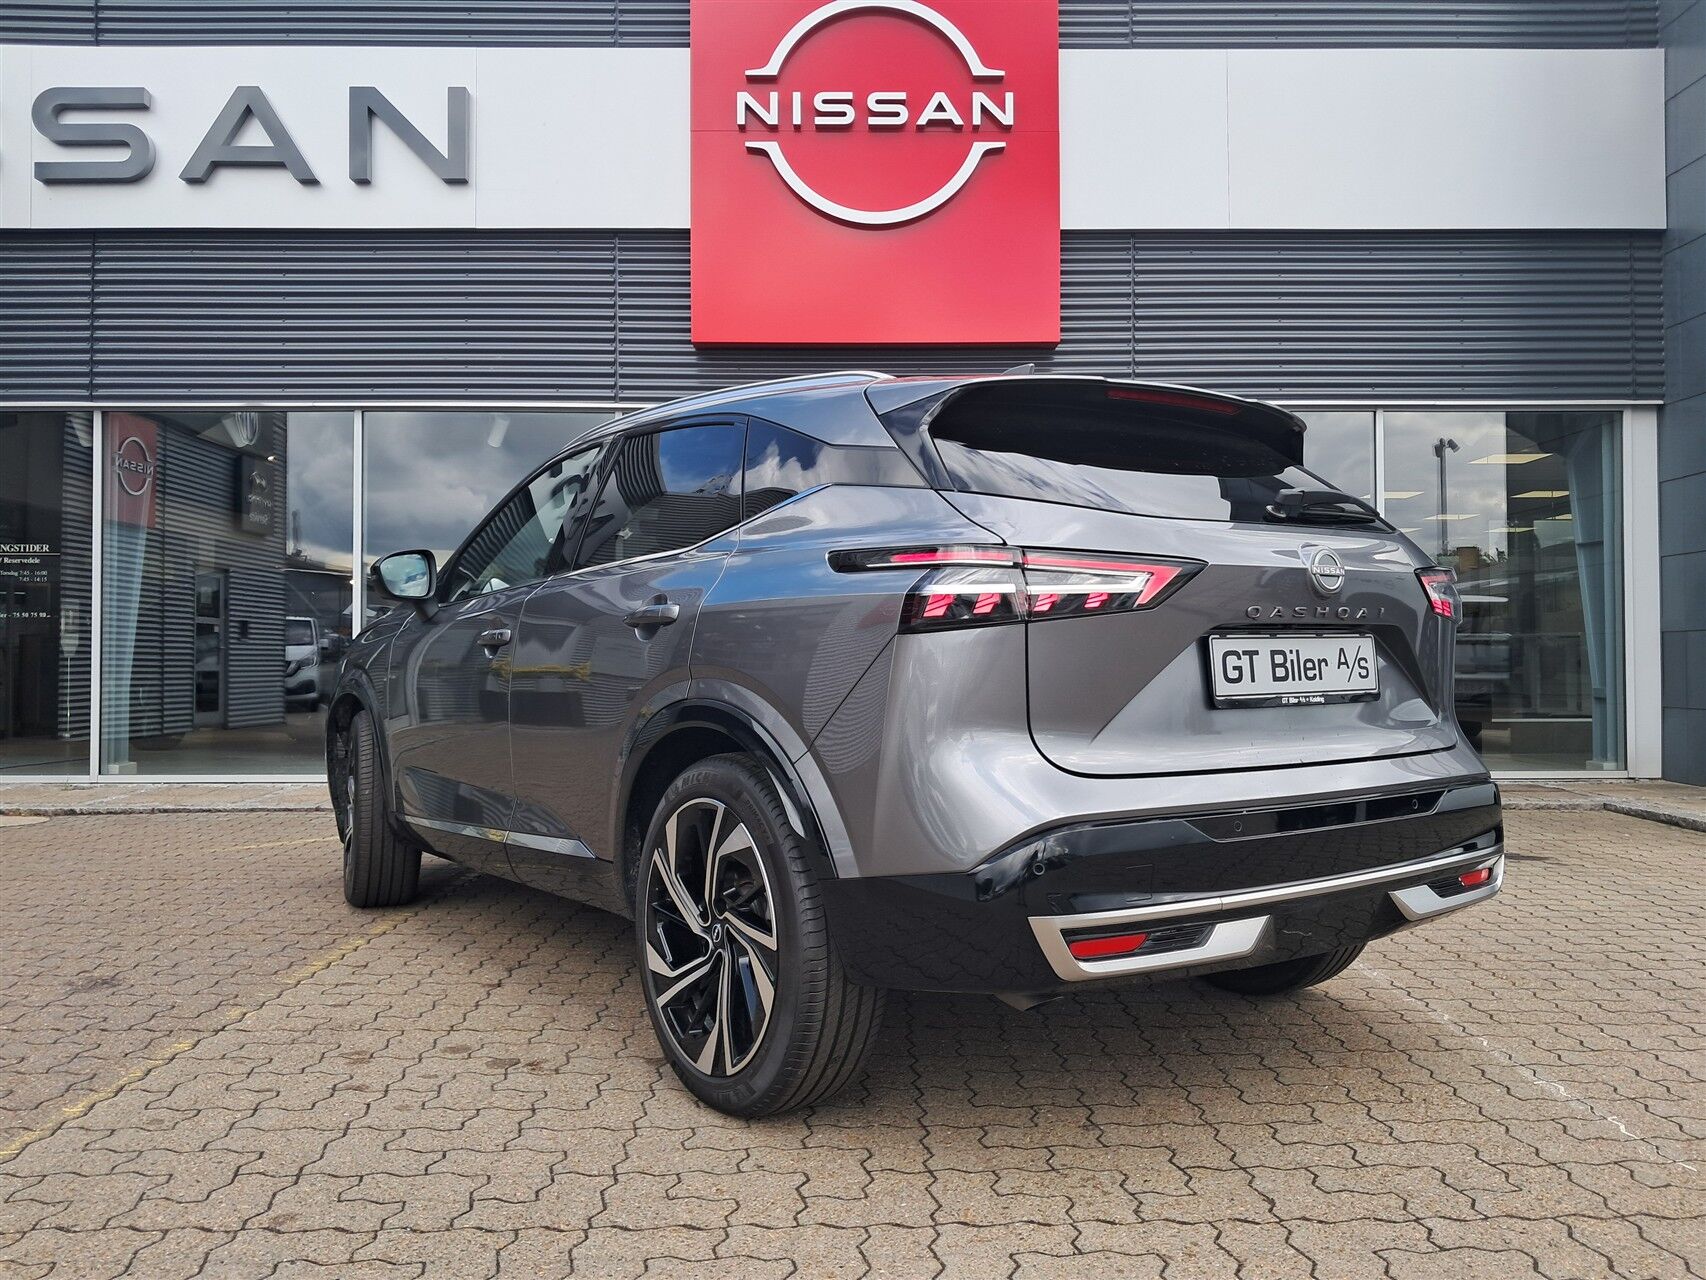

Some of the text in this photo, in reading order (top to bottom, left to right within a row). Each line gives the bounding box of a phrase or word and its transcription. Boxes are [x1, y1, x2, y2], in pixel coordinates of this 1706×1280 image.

[736, 91, 1015, 132] NISSAN
[1313, 566, 1345, 576] NISSAN
[1246, 605, 1386, 620] QASHQAI
[1222, 650, 1260, 684] GT
[1270, 649, 1329, 682] Biler
